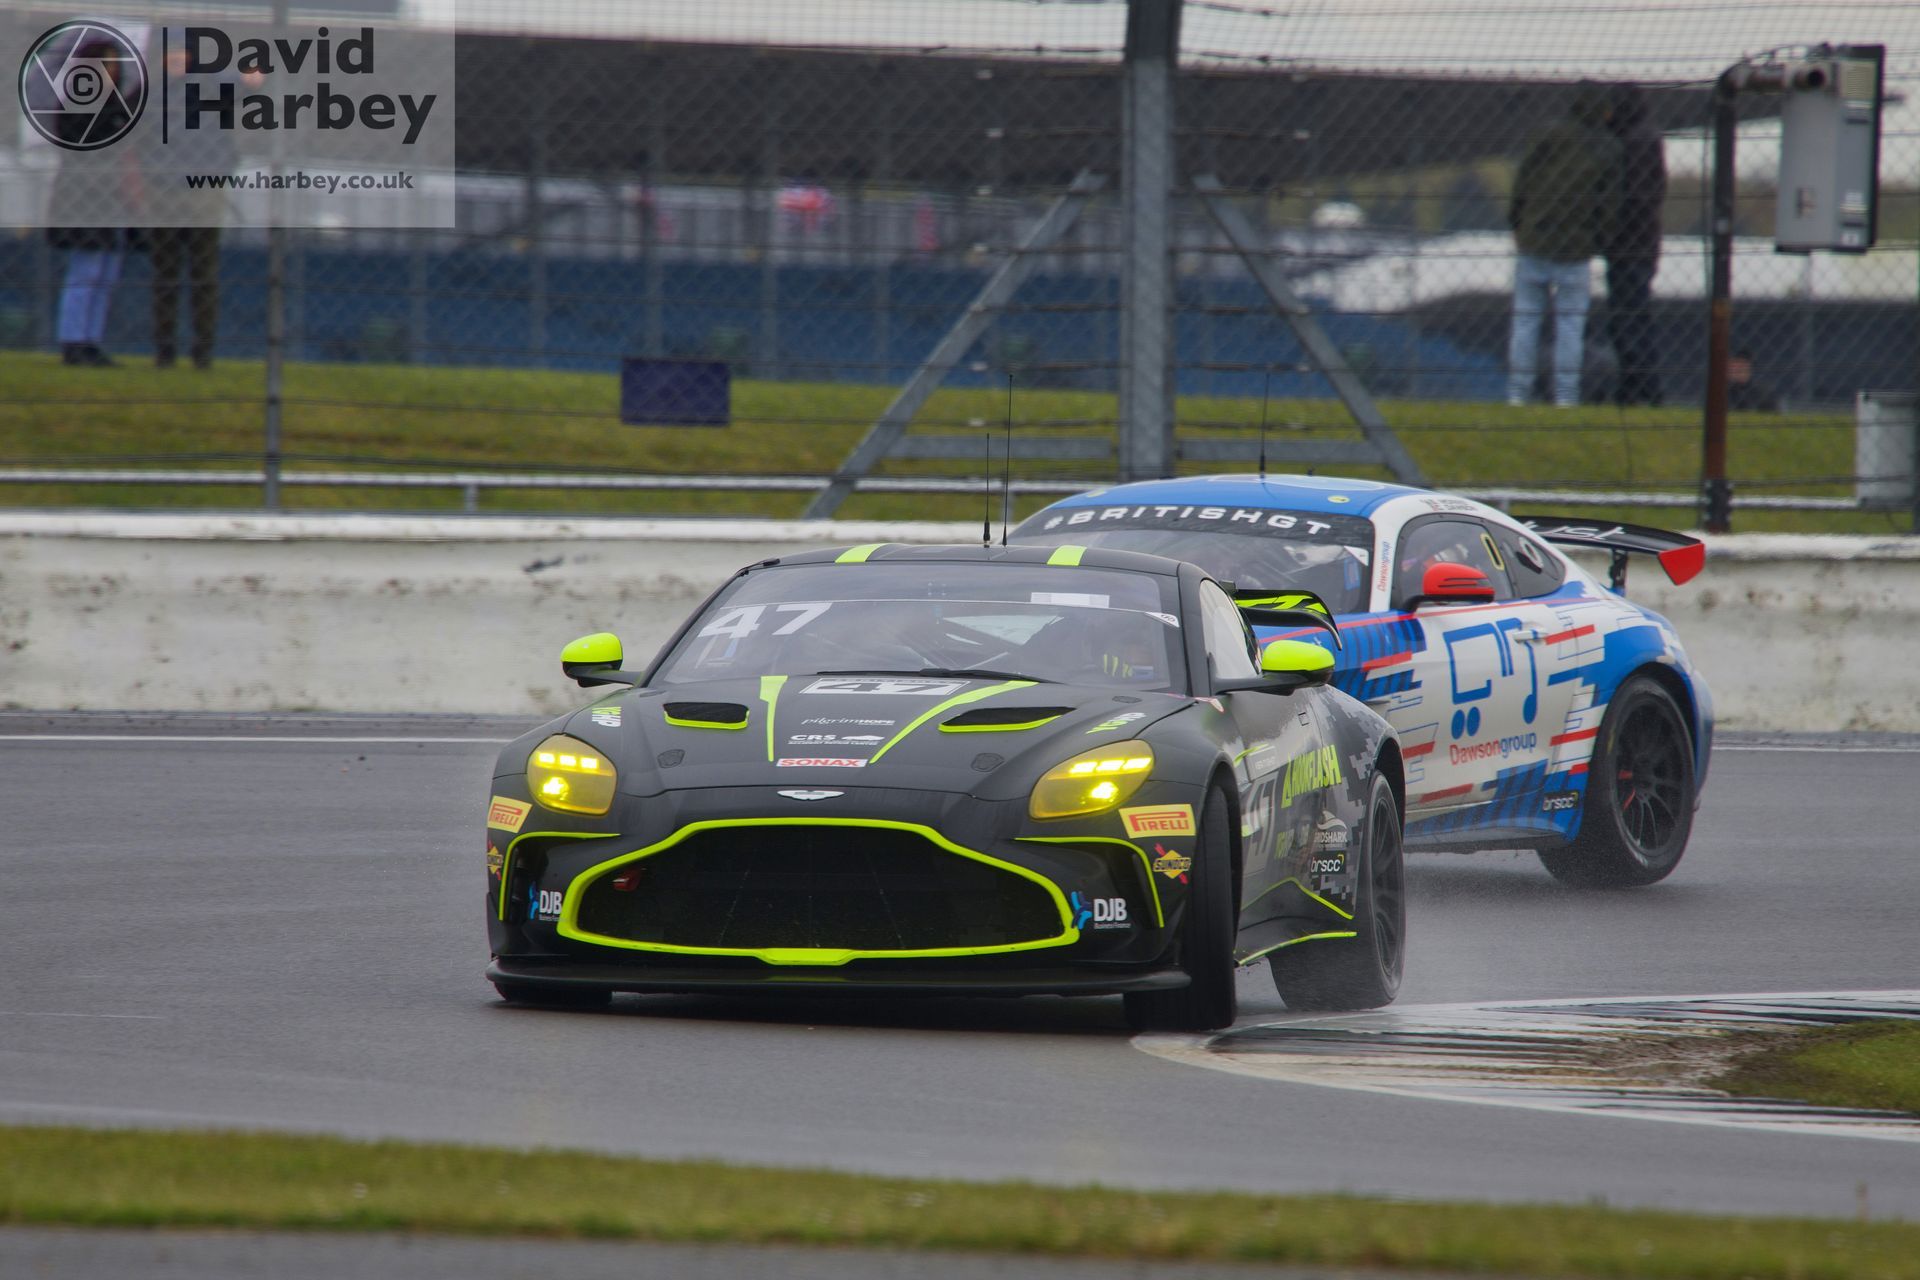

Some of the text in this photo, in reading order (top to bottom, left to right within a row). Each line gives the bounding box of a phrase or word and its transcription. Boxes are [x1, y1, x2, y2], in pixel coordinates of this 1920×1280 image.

[1044, 506, 1330, 535] #BRITISHGT
[697, 602, 833, 639] 47
[816, 682, 959, 695] 47
[1449, 732, 1537, 766] Dawsongroup
[780, 758, 860, 767] SONAX
[489, 803, 523, 827] PIRELLI
[1128, 811, 1190, 833] PIRELLI
[1310, 856, 1341, 873] brscc
[539, 890, 563, 915] DJB
[1093, 897, 1128, 922] DJB
